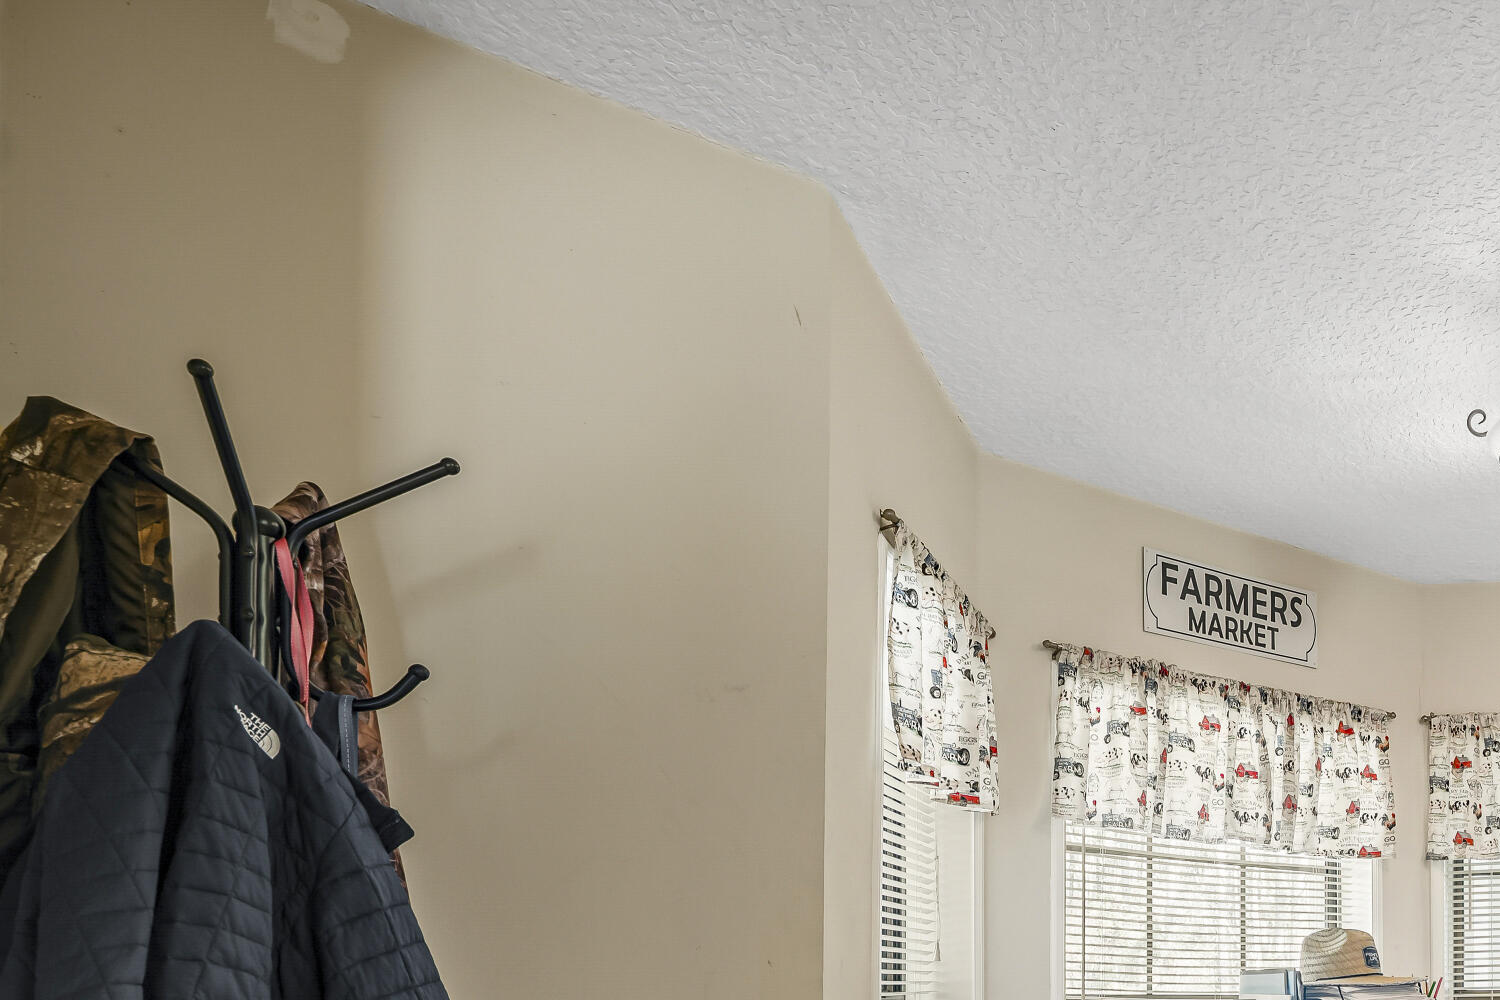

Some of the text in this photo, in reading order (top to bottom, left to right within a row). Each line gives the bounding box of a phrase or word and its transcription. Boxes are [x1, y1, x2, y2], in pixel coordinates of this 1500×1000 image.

[1161, 561, 1303, 628] FARMERS
[1188, 606, 1279, 650] MARKET
[234, 704, 268, 739] NORTH
[240, 719, 262, 743] FACE
[250, 712, 272, 732] THE
